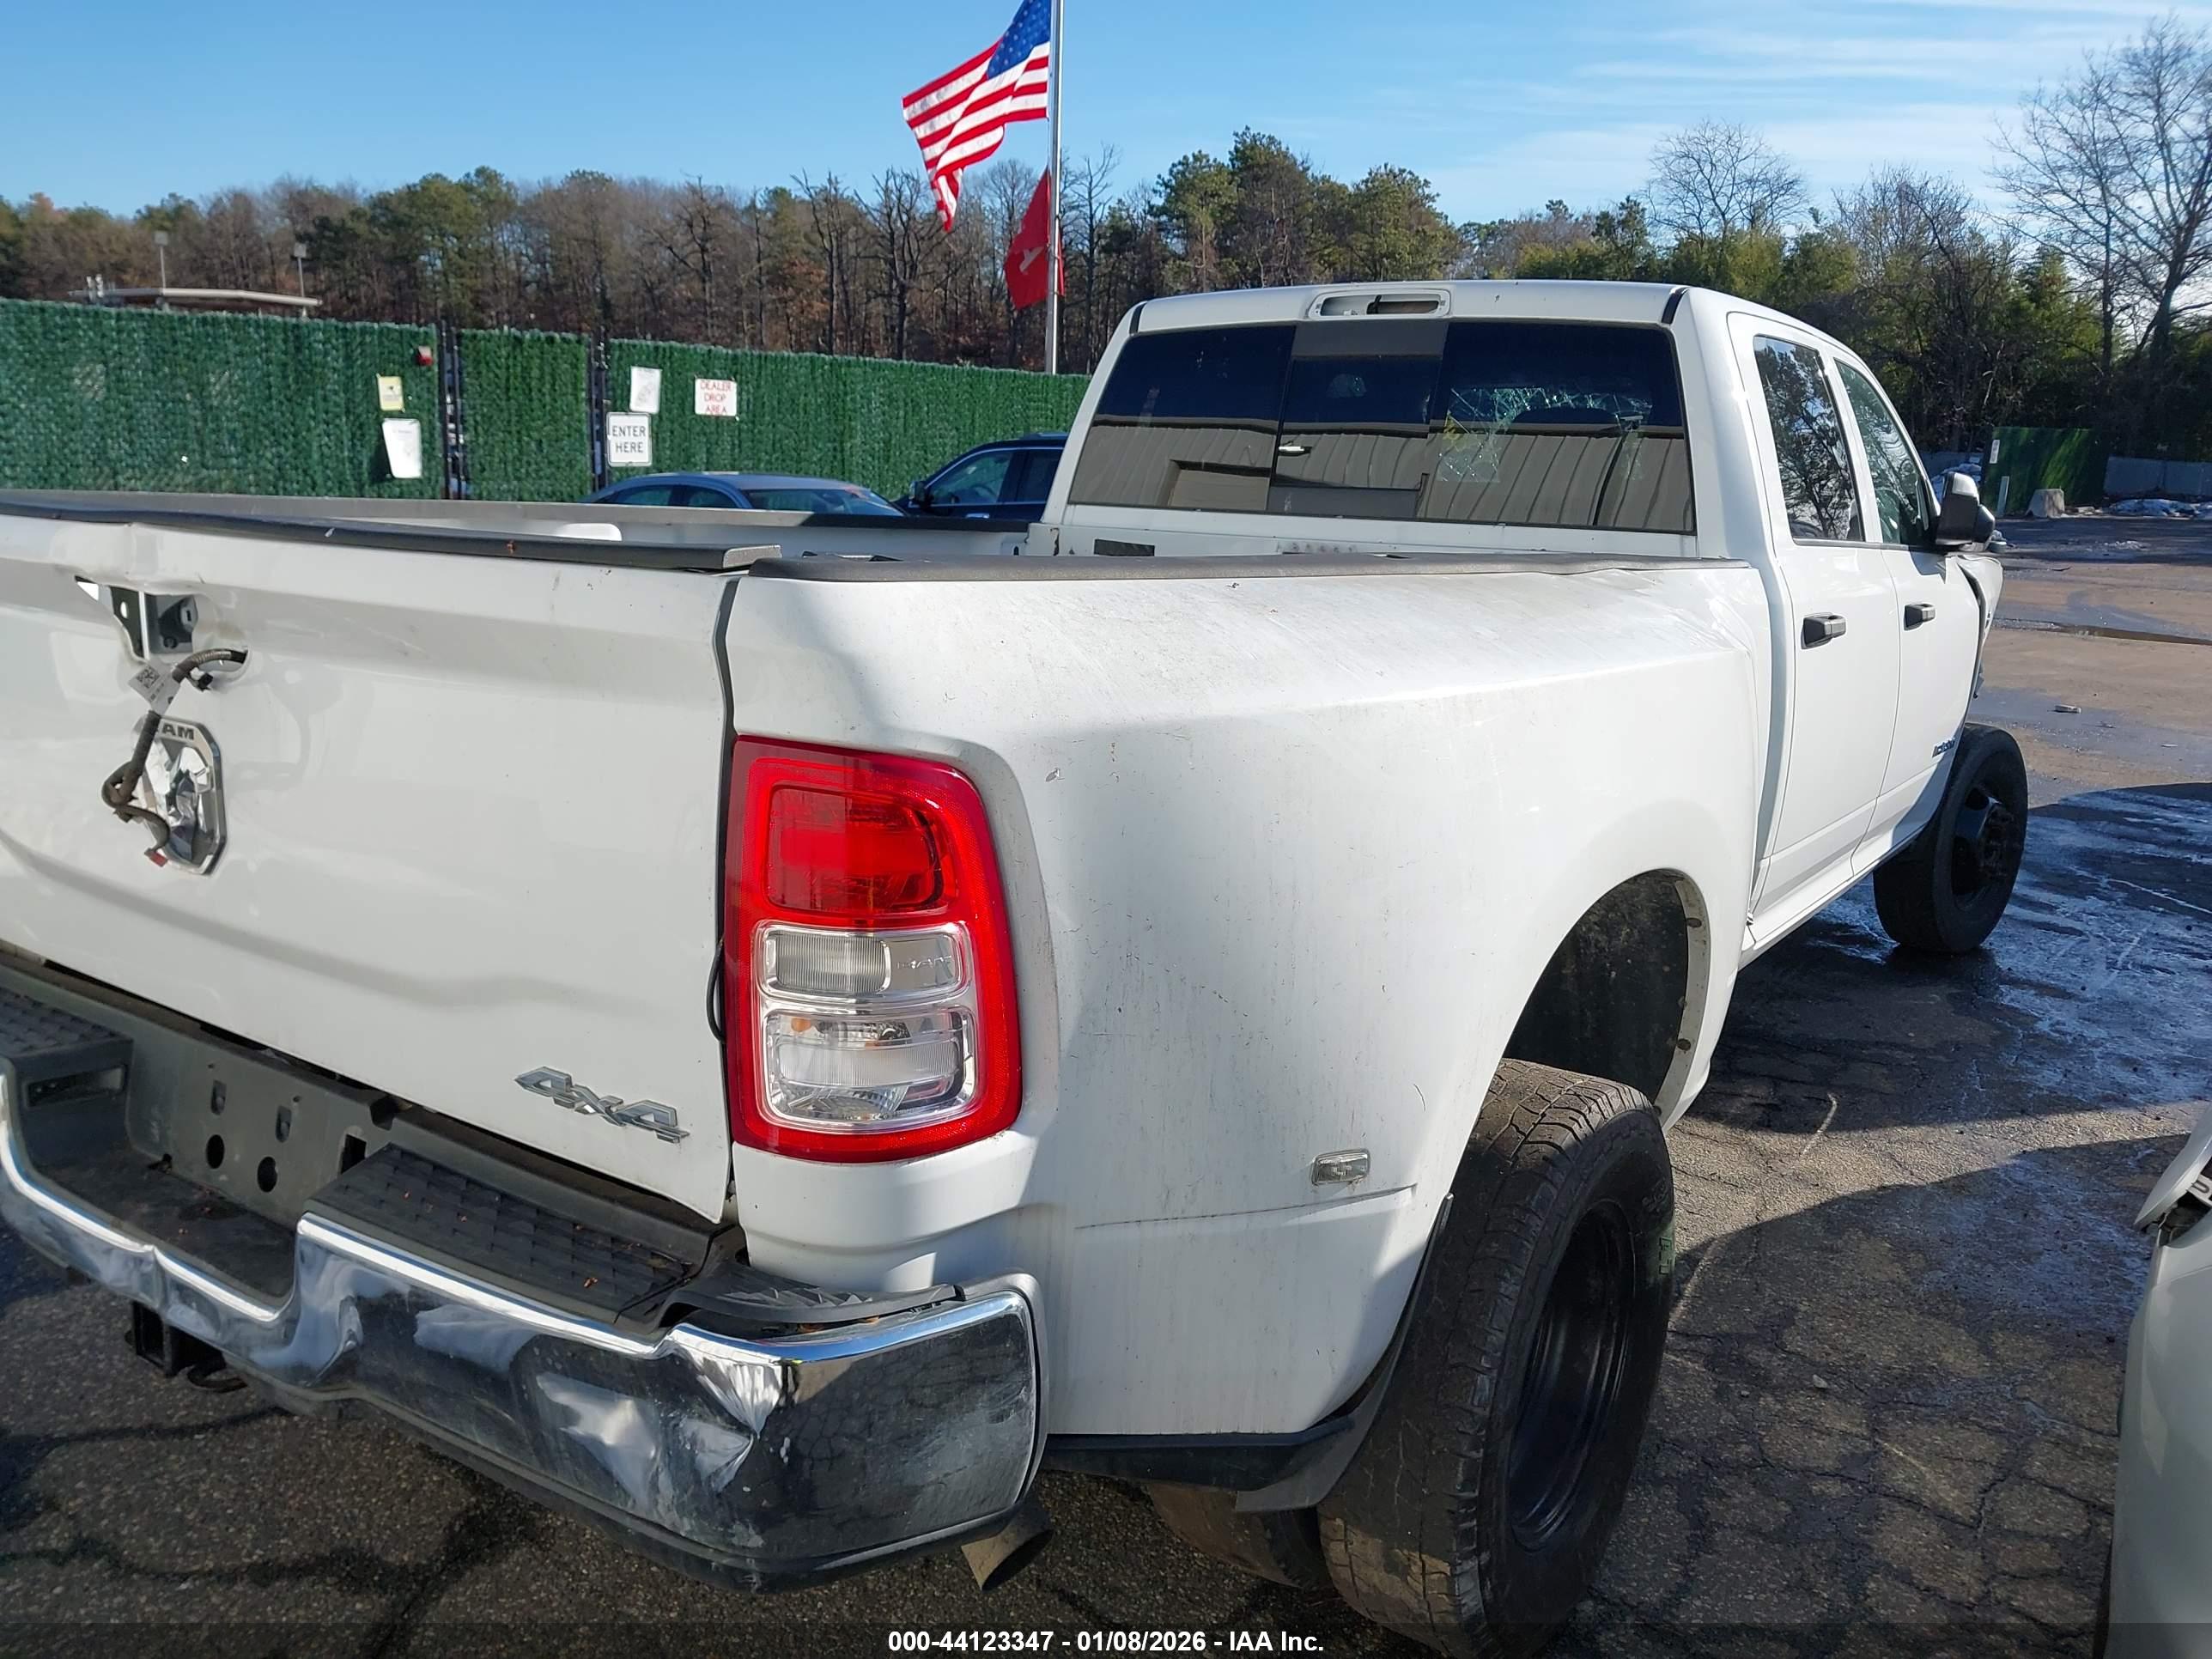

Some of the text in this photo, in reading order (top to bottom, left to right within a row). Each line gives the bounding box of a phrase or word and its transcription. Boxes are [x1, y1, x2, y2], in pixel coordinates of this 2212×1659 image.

[700, 380, 732, 392] DEALER
[704, 393, 726, 402] DROP
[706, 405, 727, 414] AREA
[612, 426, 646, 437] ENTER
[615, 442, 643, 453] HERE
[161, 723, 194, 741] AM
